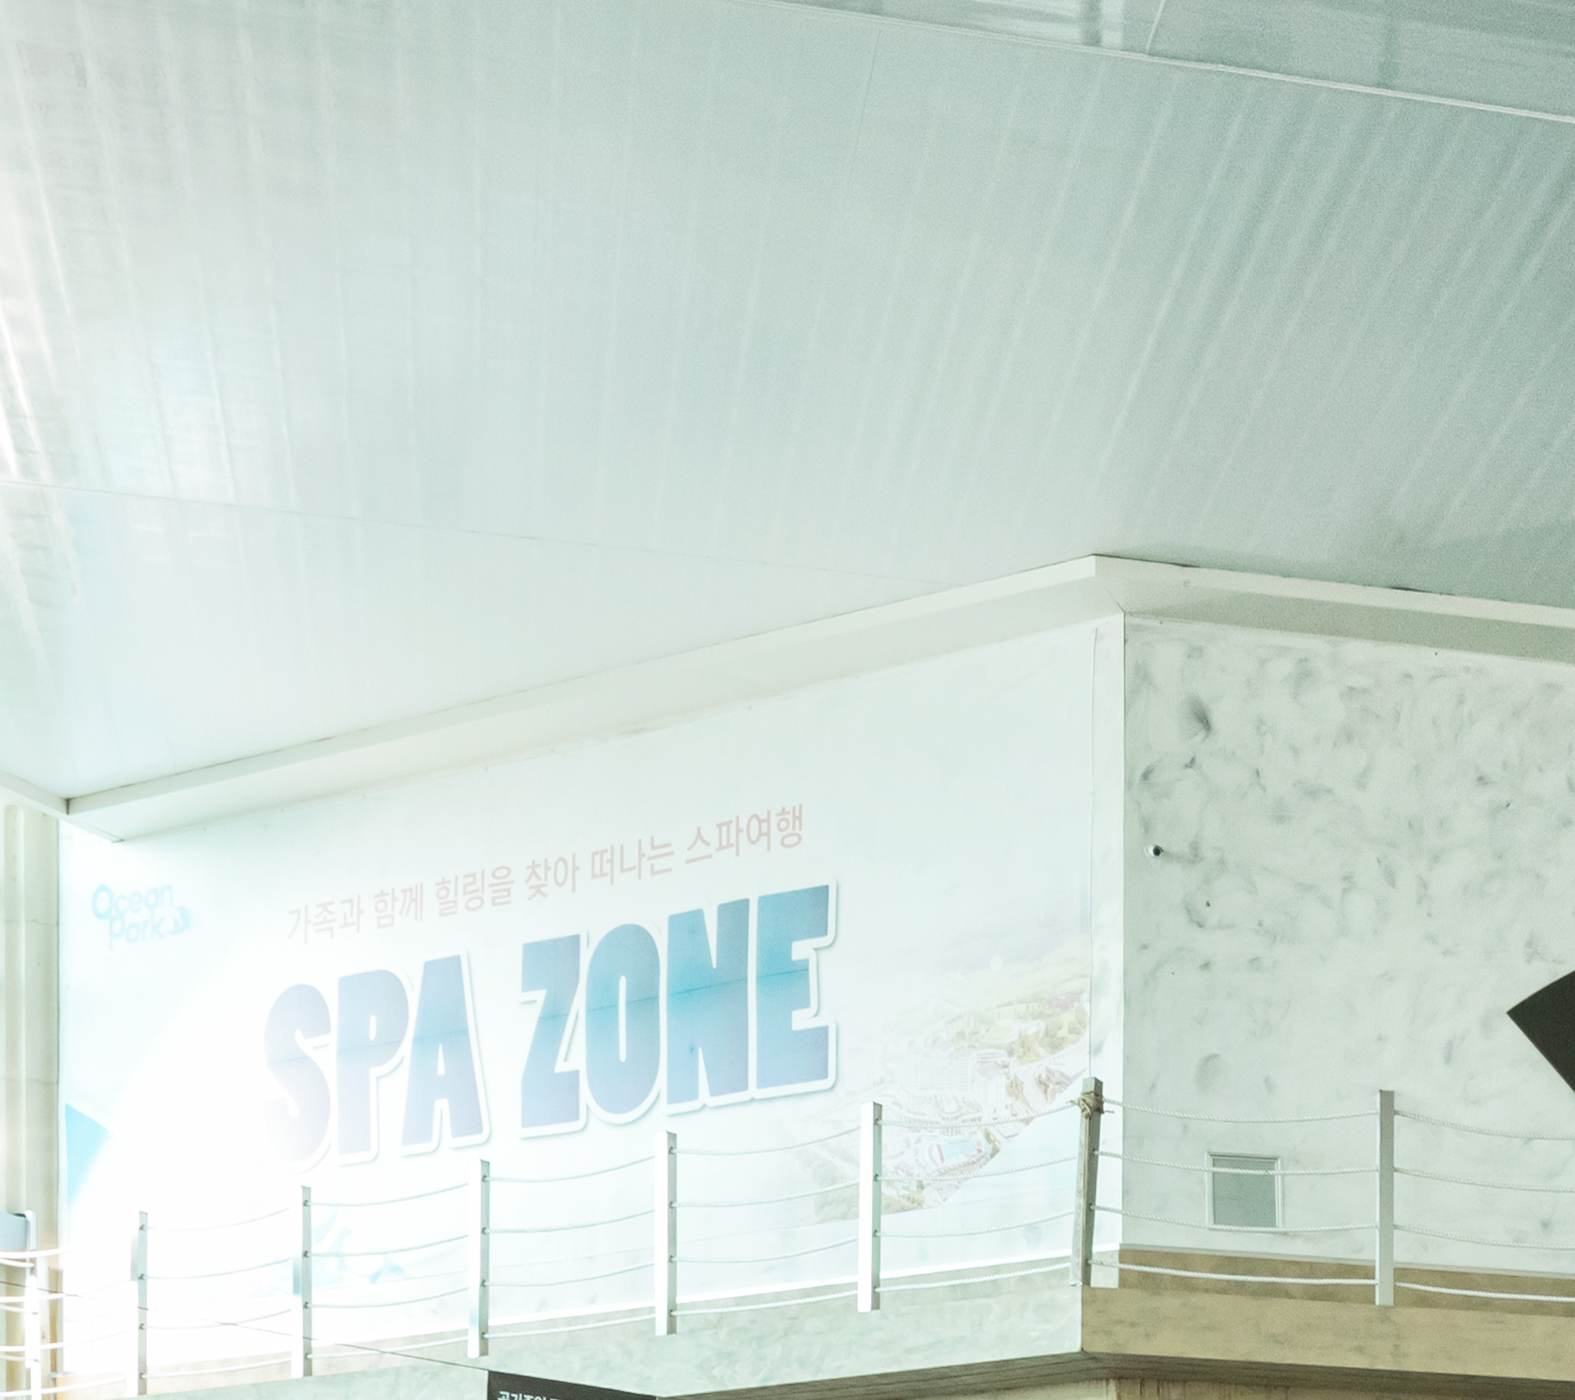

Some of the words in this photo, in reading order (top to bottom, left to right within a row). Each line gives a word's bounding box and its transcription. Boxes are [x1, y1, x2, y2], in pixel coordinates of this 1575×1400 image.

[91, 883, 174, 921] Ocean
[287, 894, 364, 944] 가족과
[374, 882, 424, 929] 함께
[434, 865, 515, 918] 힐링을
[525, 853, 580, 901] 찾아
[590, 836, 675, 886] 떠나는
[684, 803, 803, 865] 스파여행
[263, 953, 487, 1168] SPA
[520, 884, 833, 1132] ZONE
